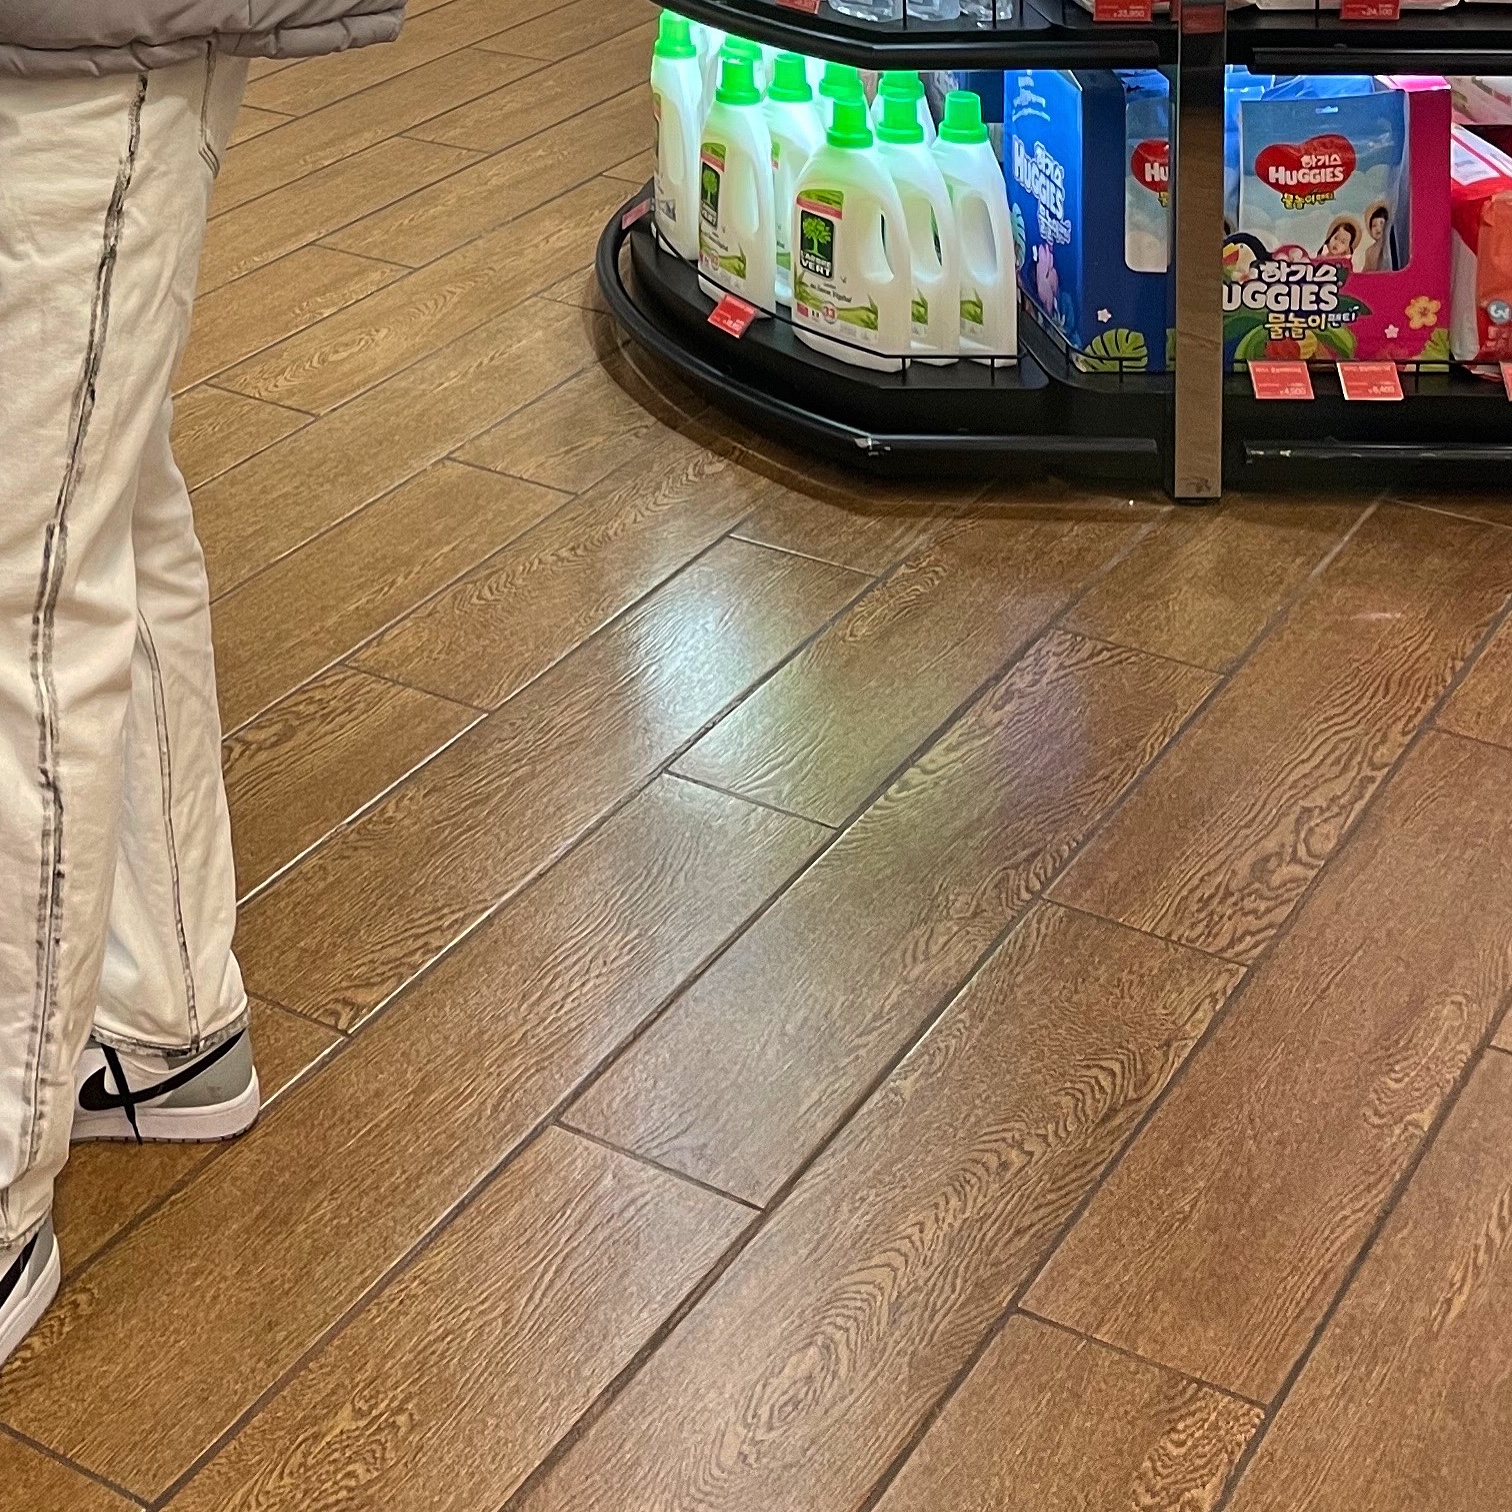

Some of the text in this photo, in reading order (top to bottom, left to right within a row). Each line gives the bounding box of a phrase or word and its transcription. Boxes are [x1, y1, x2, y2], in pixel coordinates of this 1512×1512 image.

[1300, 154, 1341, 168] 하기스
[1268, 166, 1345, 185] HUGGIES
[801, 257, 831, 277] VERT
[1259, 261, 1339, 283] 하기스
[1222, 284, 1339, 313] UGGIES
[1264, 312, 1327, 340] 물놀이
